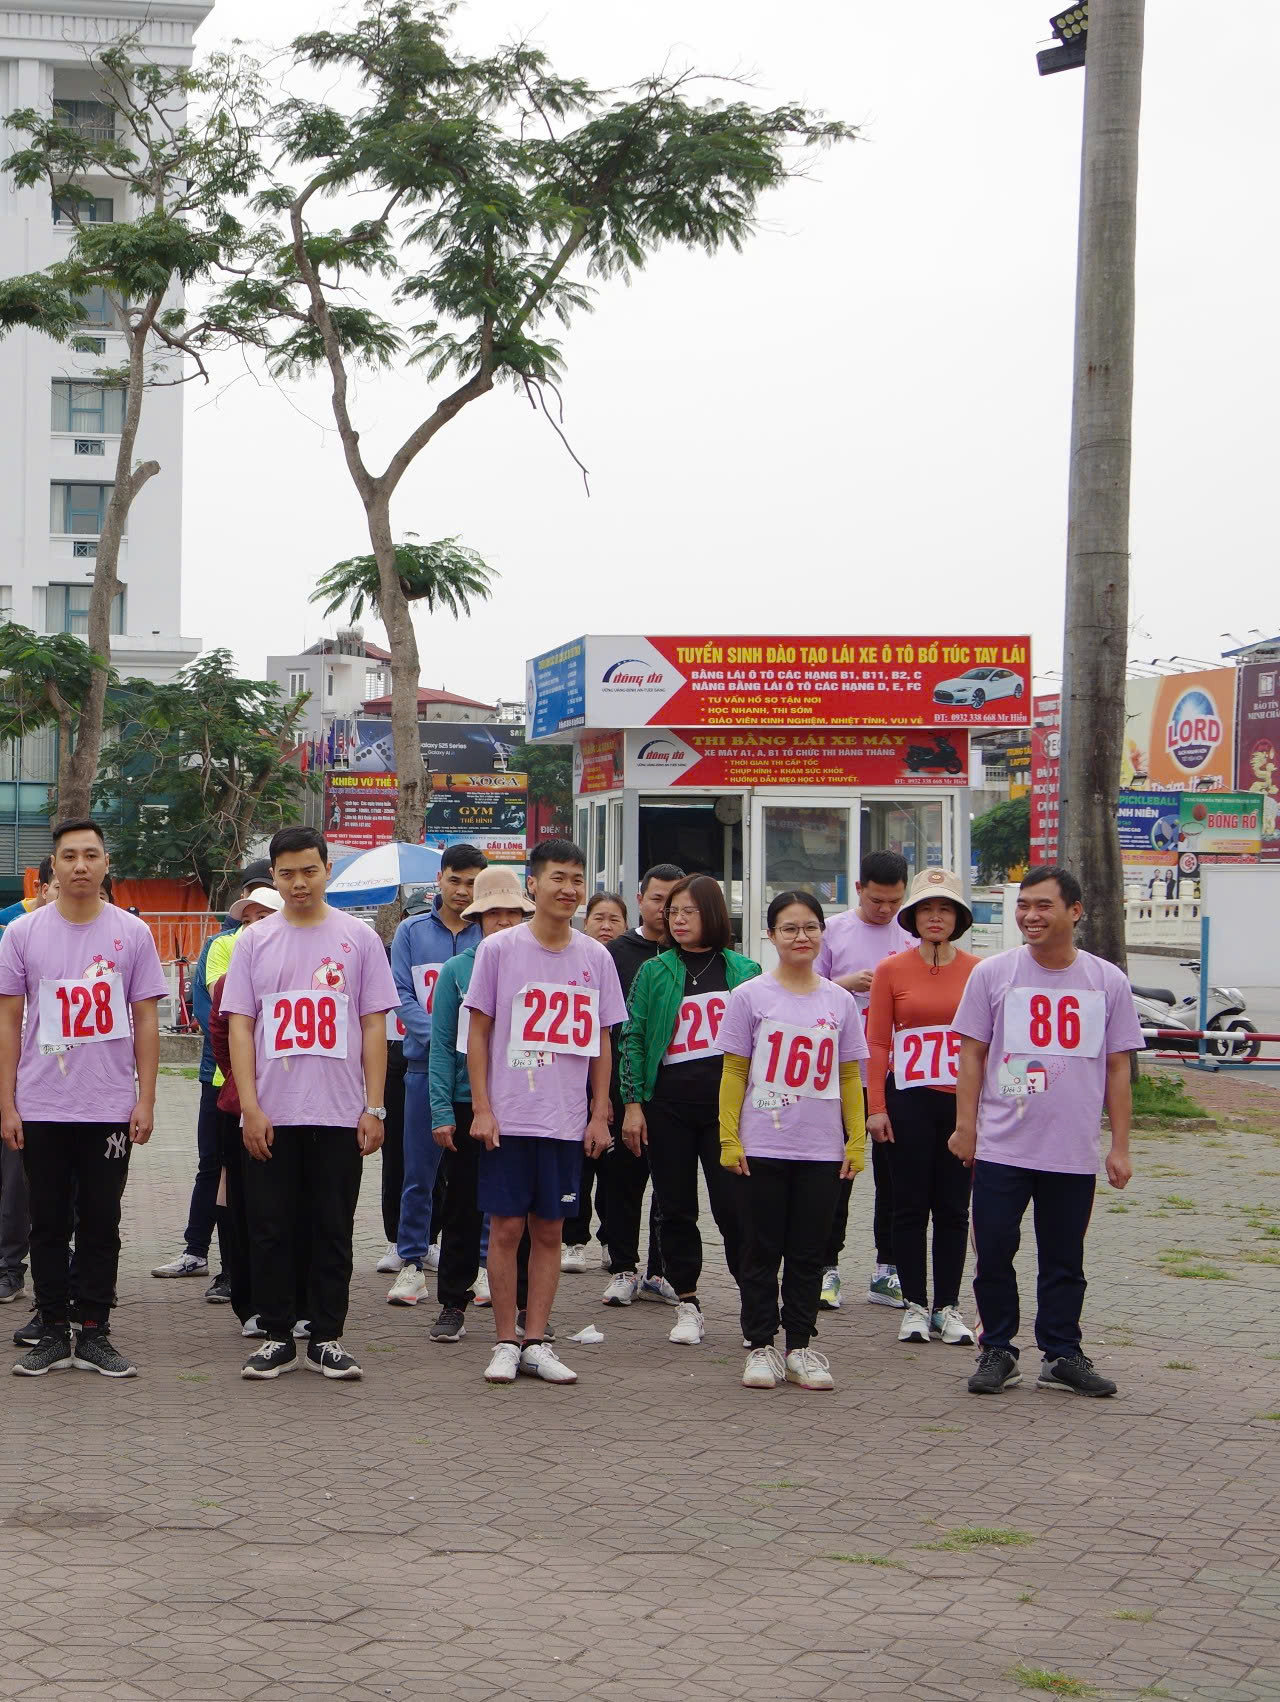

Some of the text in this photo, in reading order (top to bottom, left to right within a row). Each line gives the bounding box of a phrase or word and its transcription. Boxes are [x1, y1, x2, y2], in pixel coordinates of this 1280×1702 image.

[676, 641, 1026, 666] TUYỂN SINH ĐÀO TẠO LÁI XE Ô TÔ BỔ TÚC TAY LÁI
[727, 669, 746, 680] LÁI
[749, 669, 755, 680] Ô
[760, 669, 775, 680] TÔ
[780, 669, 801, 680] CÁC
[805, 671, 837, 682] HẠNG
[840, 671, 859, 680] B1,
[862, 671, 888, 680] B11,
[891, 671, 910, 680] B2,
[914, 671, 922, 680] C
[692, 680, 725, 691] NÂNG
[764, 680, 782, 691] LÁI
[786, 680, 793, 691] Ô
[797, 680, 812, 691] TÔ
[815, 680, 838, 691] CÁC
[842, 682, 875, 692] HẠNG
[877, 682, 889, 691] D,
[893, 682, 904, 691] E,
[907, 682, 922, 691] FC
[708, 707, 729, 716] HỌC
[732, 707, 770, 715] NHANH,
[791, 706, 813, 714] SỚM
[1248, 709, 1280, 720] MINH CHÂ
[708, 716, 733, 725] GIÁO
[736, 716, 759, 725] VIÊN
[762, 717, 783, 725] KINH
[787, 716, 828, 726] NGHIỆM,
[831, 716, 859, 726] NHIỆT
[862, 716, 888, 725] TÌNH,
[891, 717, 908, 725] VUI
[934, 714, 948, 722] ĐT:
[951, 714, 968, 722] 0932
[969, 714, 982, 722] 338
[983, 714, 996, 722] 668
[997, 714, 1009, 722] Mr
[692, 736, 727, 746] THI
[793, 733, 826, 746] LÁI
[831, 736, 857, 746] XE
[863, 734, 907, 746] MÁY
[1168, 719, 1220, 748] LORD
[420, 742, 437, 750] alaxy
[718, 748, 738, 757] MÁY
[783, 747, 794, 757] TỔ
[797, 748, 819, 757] CHỨC
[838, 748, 863, 757] HÀNG
[866, 748, 896, 757] THÁNG
[785, 758, 801, 766] CẤP
[803, 758, 819, 766] TỐC
[469, 776, 520, 787] YOGA
[1119, 795, 1178, 806] PICKLEBALL
[459, 807, 494, 815] GYM
[1135, 807, 1159, 818] NIÊN
[460, 816, 493, 824] THỂ HÌNH
[1242, 809, 1259, 829] RỔ
[504, 841, 523, 850] LÔNG
[336, 876, 395, 889] mobifone
[56, 981, 114, 1038] 128
[273, 996, 337, 1051] 298
[522, 988, 593, 1047] 225
[1030, 994, 1081, 1050] 86
[667, 998, 726, 1056] 226
[765, 1031, 834, 1091] 169
[903, 1030, 961, 1082] 275
[104, 1131, 128, 1160] NY
